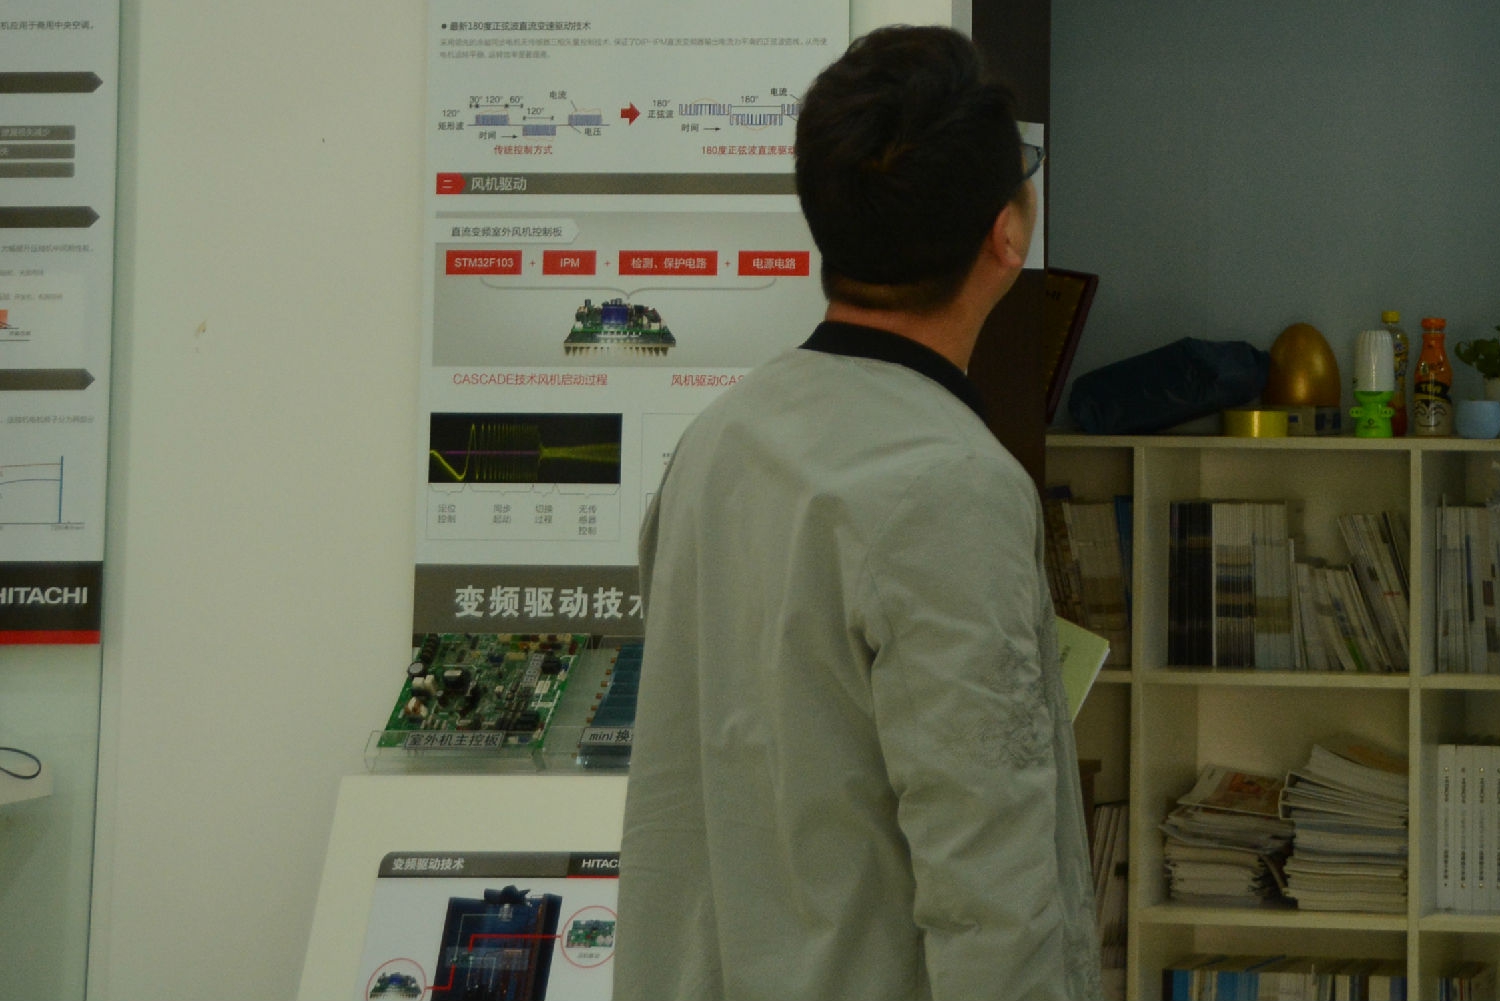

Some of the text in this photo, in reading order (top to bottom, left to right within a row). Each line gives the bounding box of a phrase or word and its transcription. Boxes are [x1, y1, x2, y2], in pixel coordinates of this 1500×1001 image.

[549, 90, 567, 100] 电流
[770, 87, 788, 96] 电流
[647, 109, 675, 119] 正弦波
[584, 127, 602, 137] 电压
[681, 123, 700, 133] 时间
[478, 131, 497, 141] 时间
[471, 176, 527, 191] 风机驱动
[453, 257, 514, 268] STM32F103
[559, 258, 580, 268] IPM
[631, 257, 707, 270] 检测、保护电路
[752, 258, 796, 270] 电源电路
[453, 373, 608, 386] CASCADE技术风机启动过程
[408, 732, 501, 747] 室外机主控板
[588, 731, 614, 742] mini
[392, 858, 464, 871] 变频驱动技术
